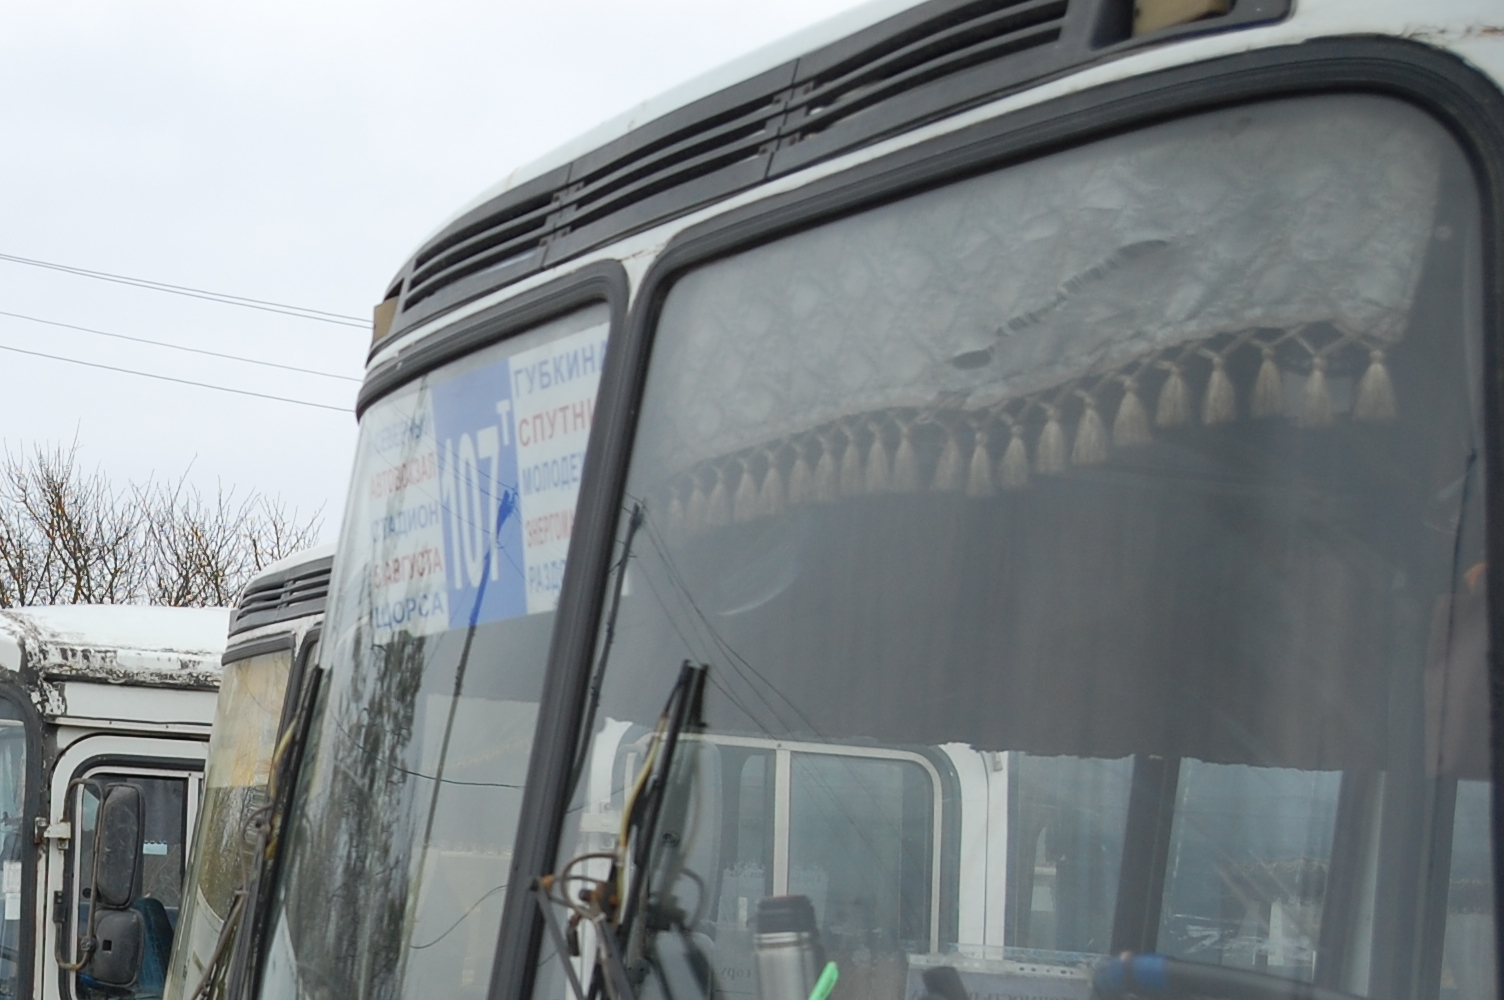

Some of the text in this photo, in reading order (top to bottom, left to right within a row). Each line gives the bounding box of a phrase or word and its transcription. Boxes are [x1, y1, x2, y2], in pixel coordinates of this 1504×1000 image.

[372, 501, 439, 544] СТАДИОН
[382, 547, 443, 586] АВГУСТА
[375, 592, 444, 632] ЩОРСА
